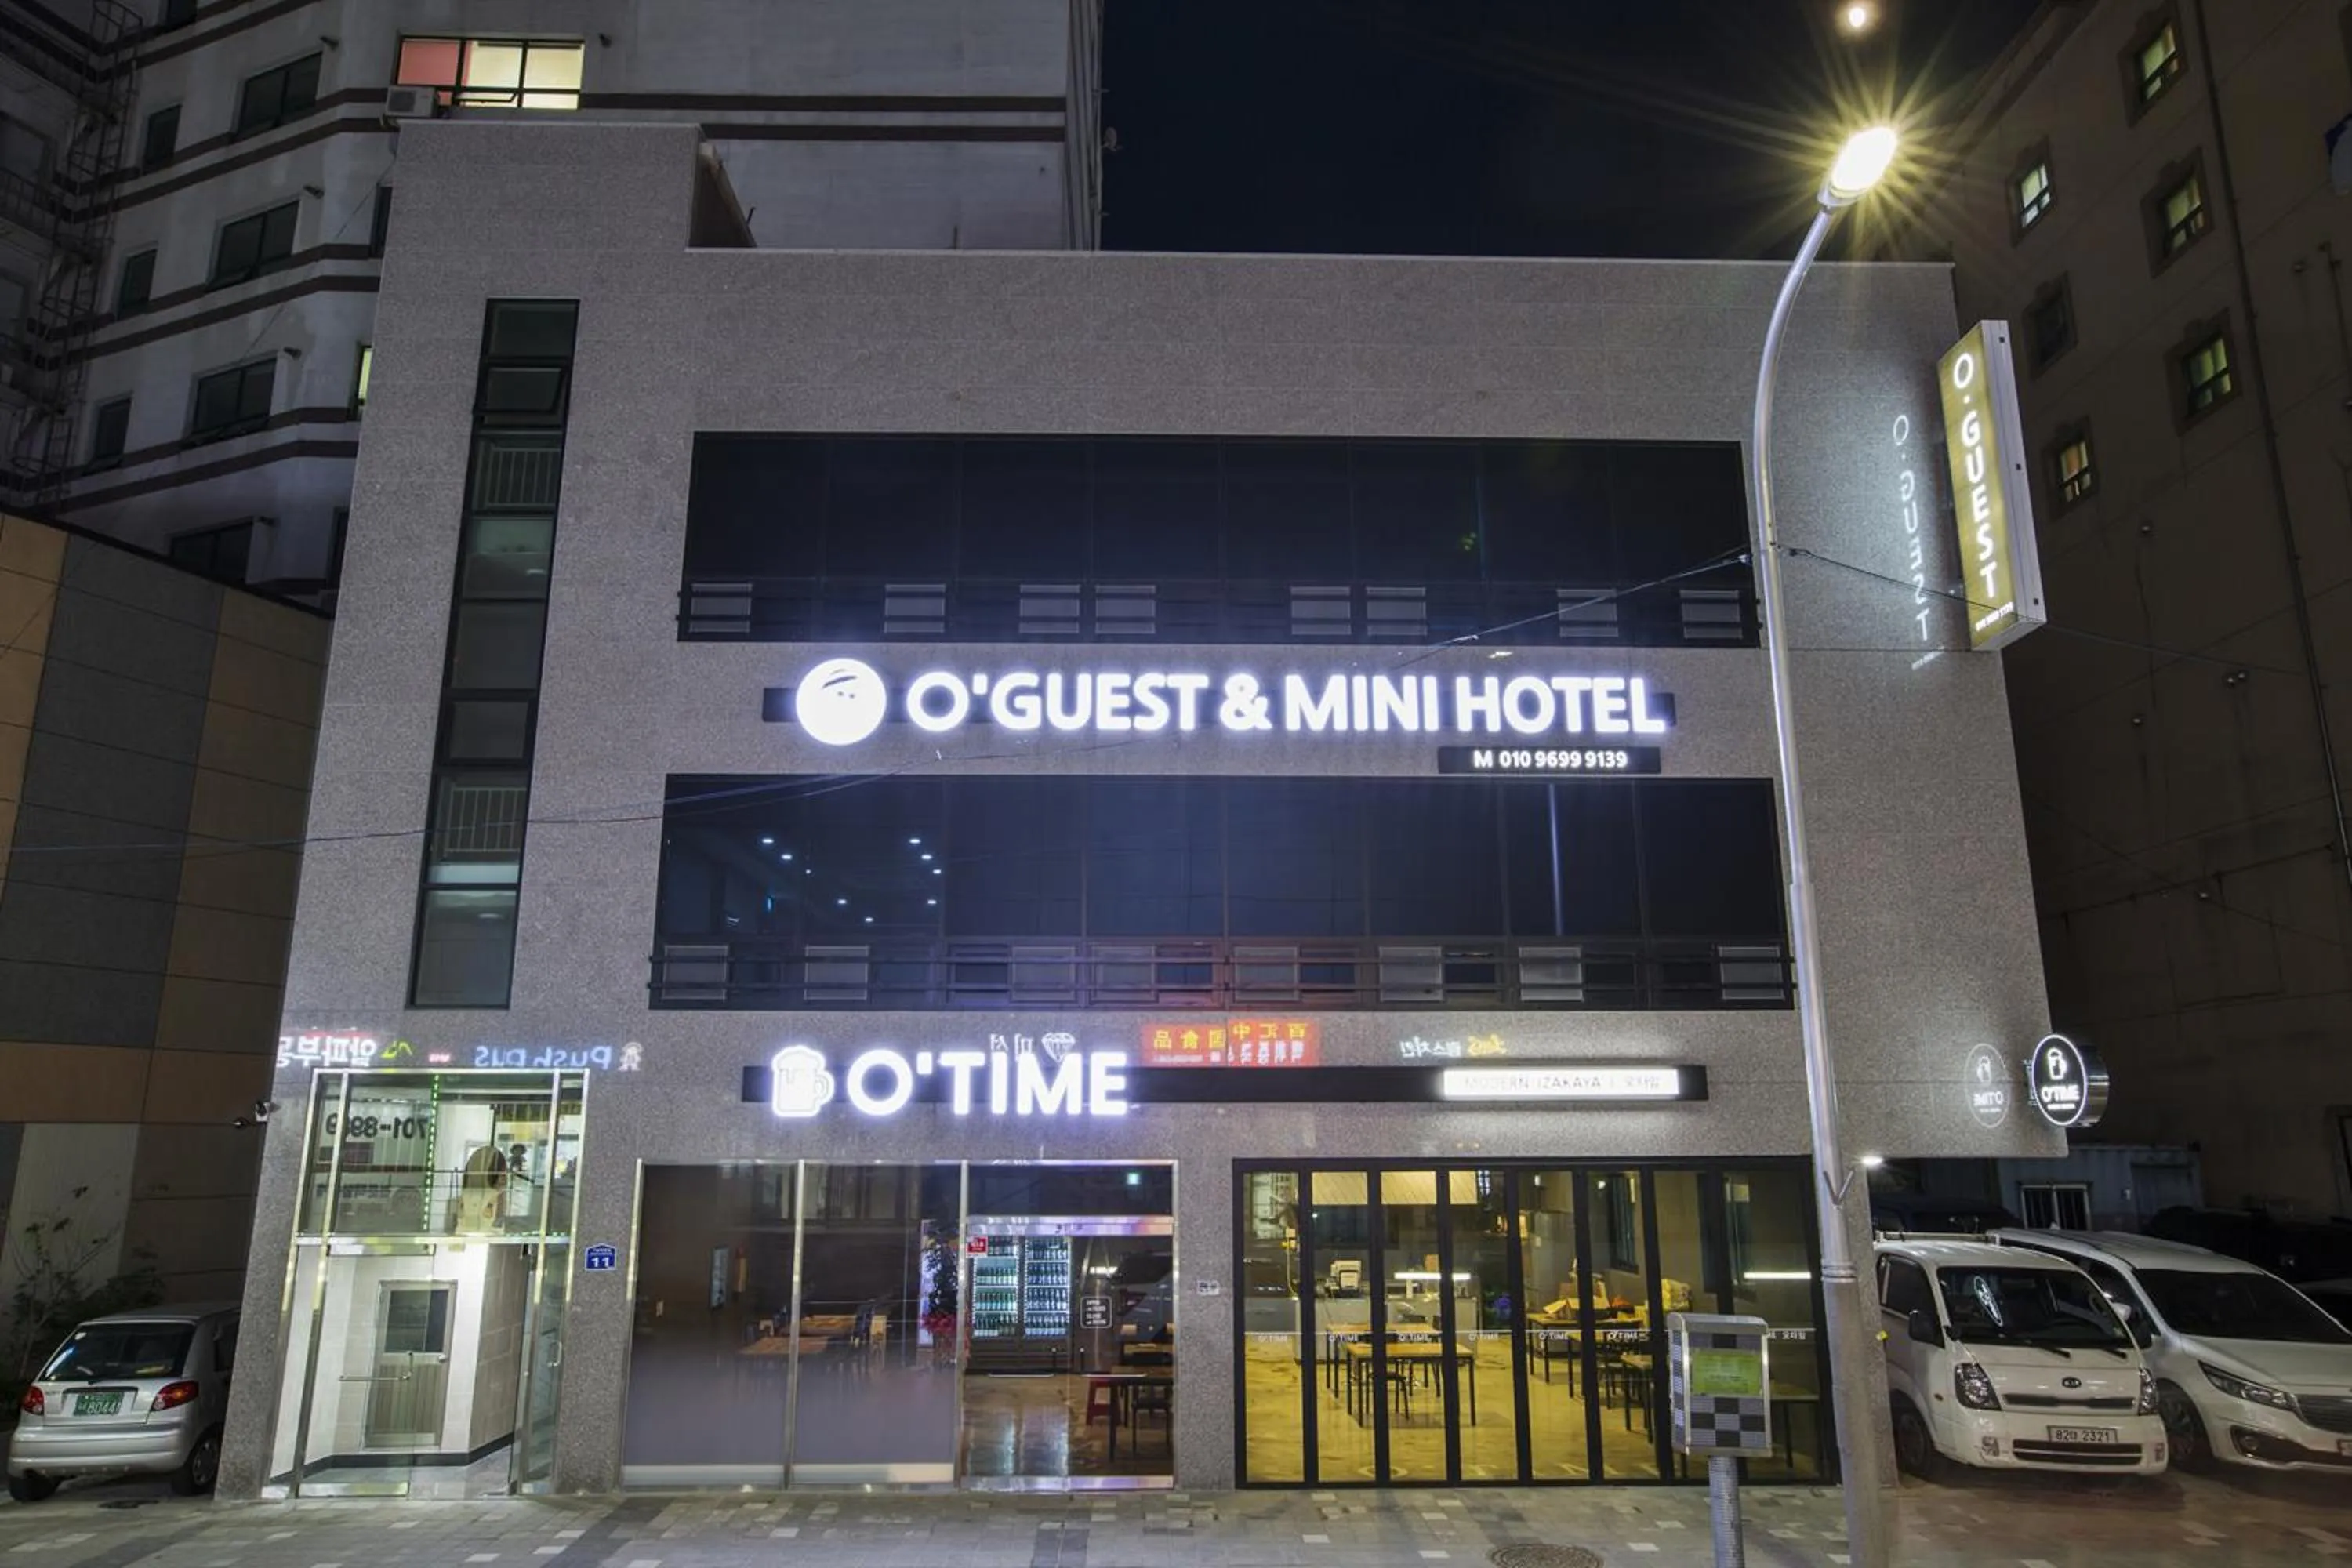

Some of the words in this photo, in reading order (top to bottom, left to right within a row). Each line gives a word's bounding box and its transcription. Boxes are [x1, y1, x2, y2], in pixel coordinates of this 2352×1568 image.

[906, 670, 1210, 731] O'GUEST
[1219, 673, 1273, 731] &
[1284, 673, 1439, 731] MINI
[1455, 675, 1666, 734] HOTEL
[1473, 750, 1493, 768] M
[1499, 750, 1531, 768] 010
[1534, 750, 1582, 768] 9699
[1584, 750, 1628, 768] 9139
[846, 1049, 1127, 1116] O'TIME
[591, 1257, 609, 1268] 11
